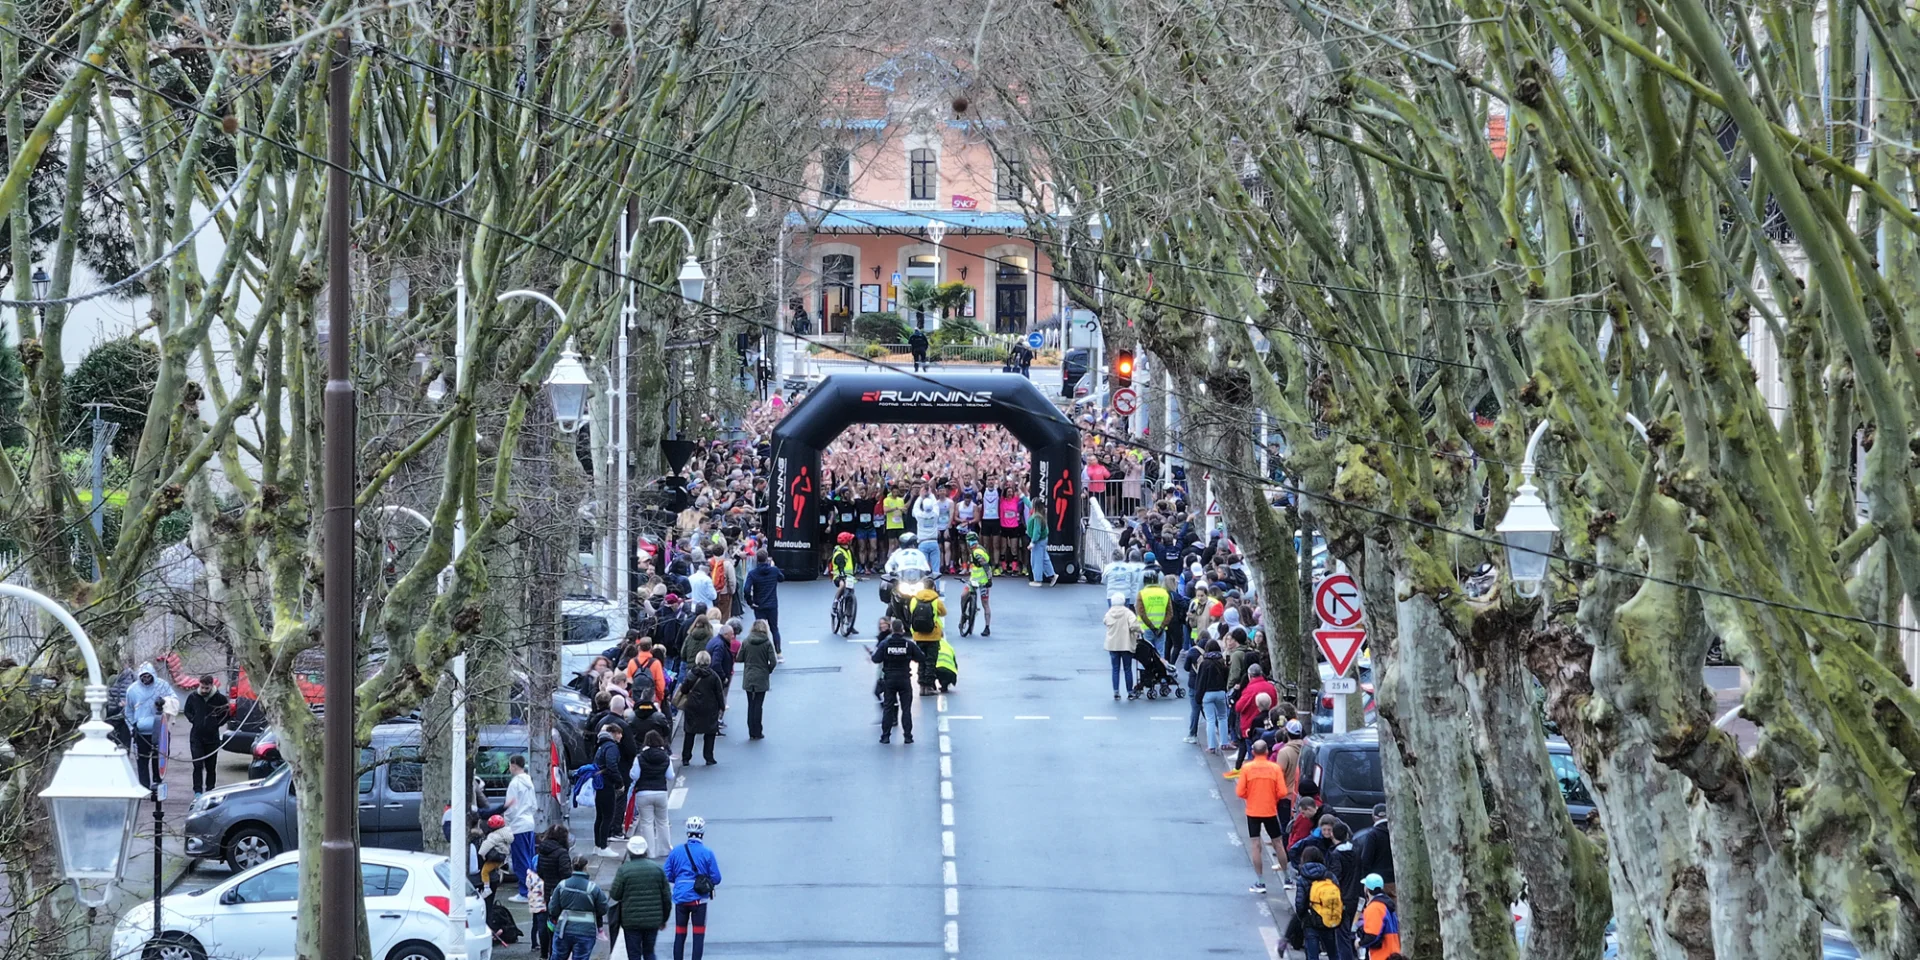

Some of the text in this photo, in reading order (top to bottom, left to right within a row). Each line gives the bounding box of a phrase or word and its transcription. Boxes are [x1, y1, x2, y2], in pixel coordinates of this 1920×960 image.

[953, 200, 976, 208] SNCF
[879, 391, 993, 402] RUNNING
[776, 457, 785, 528] RUNNING
[774, 540, 811, 549] Montauban
[1046, 544, 1074, 552] ntauban
